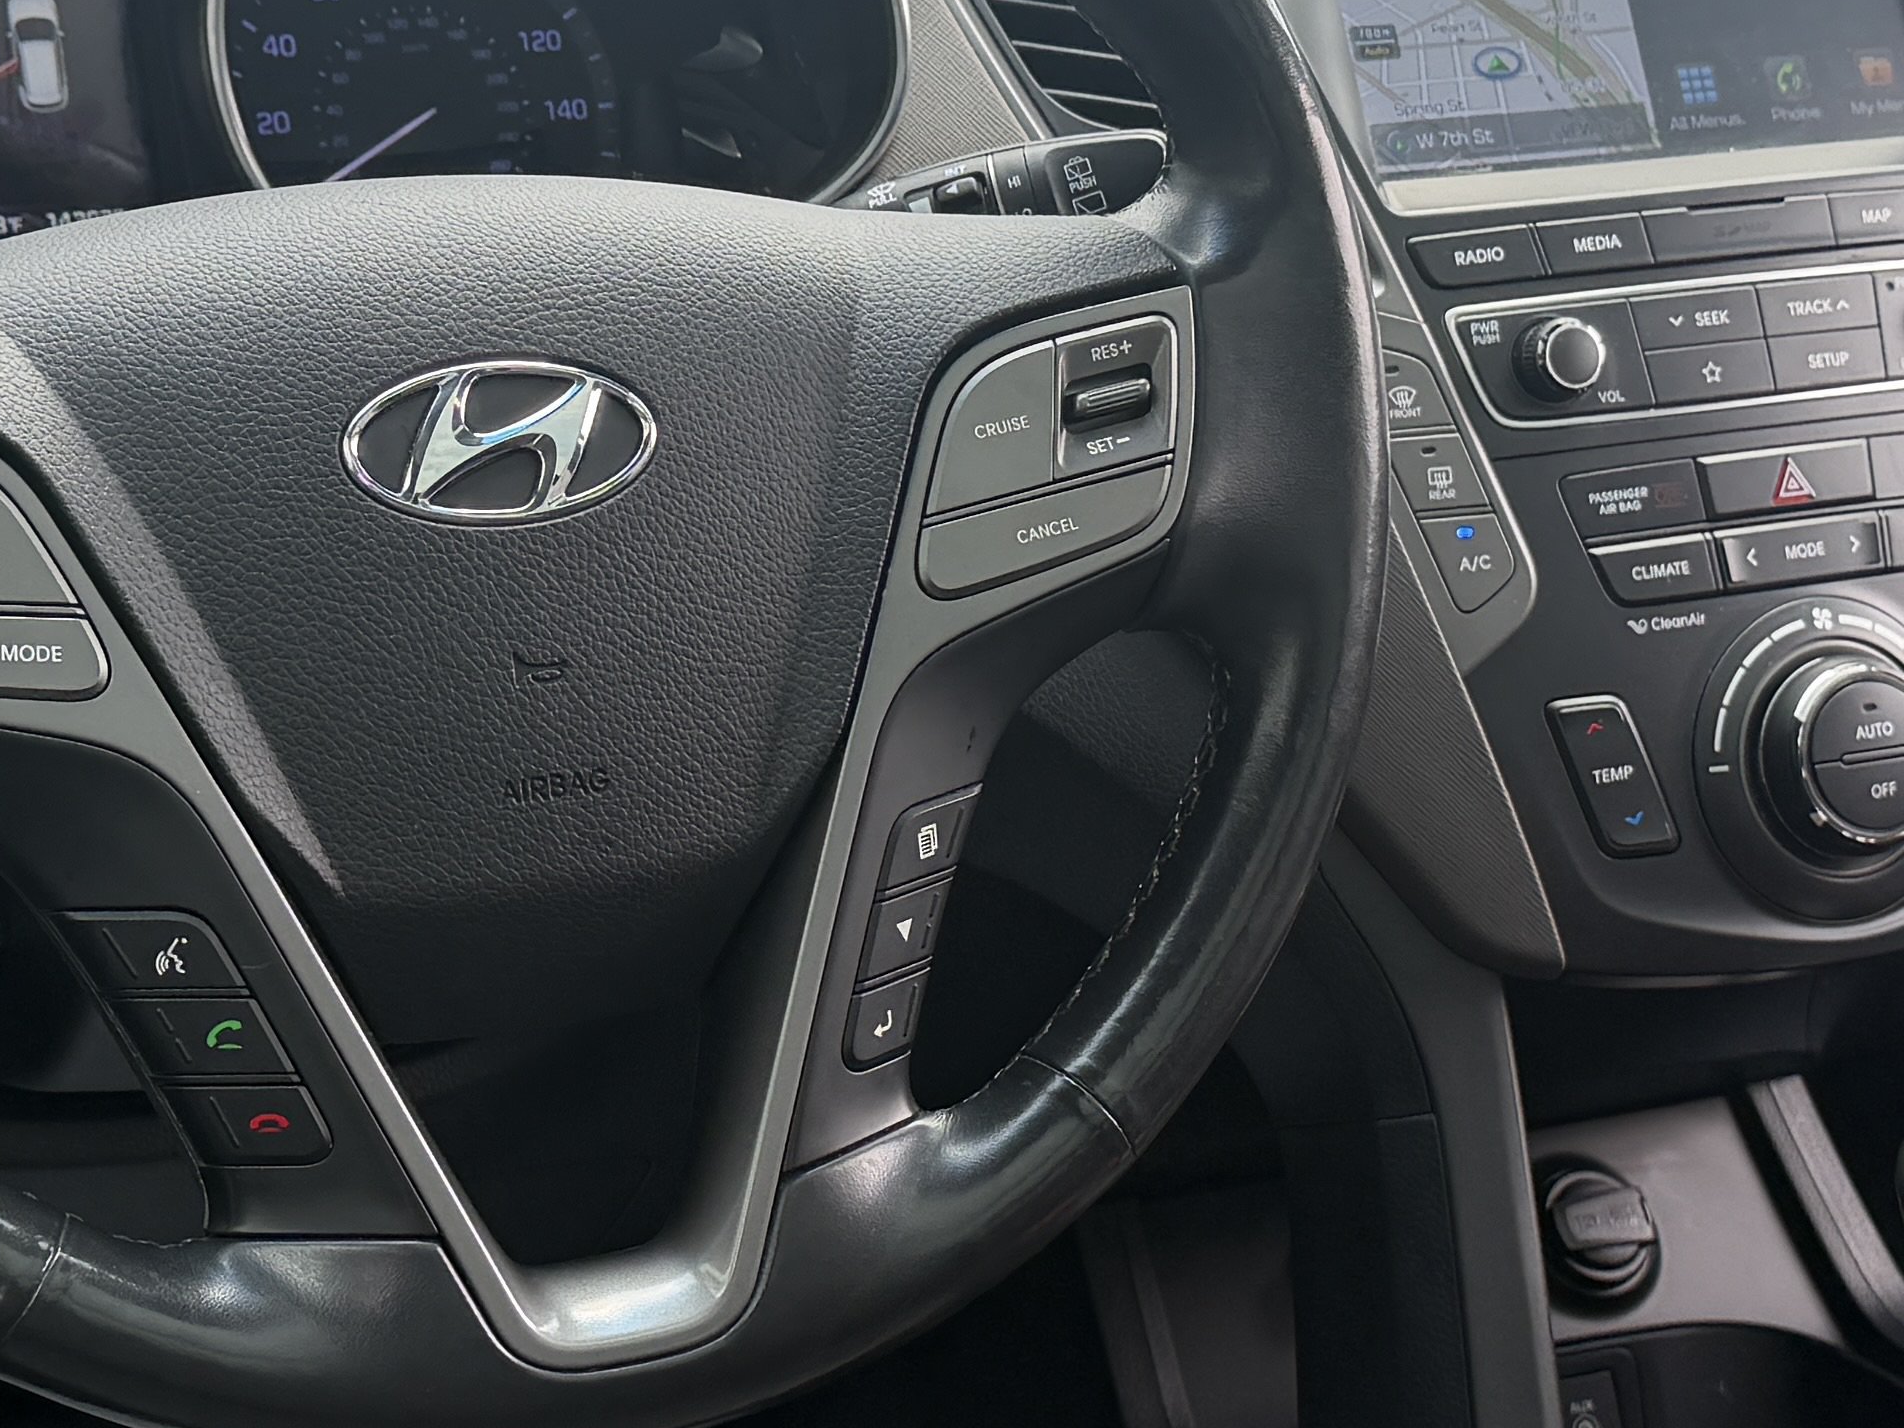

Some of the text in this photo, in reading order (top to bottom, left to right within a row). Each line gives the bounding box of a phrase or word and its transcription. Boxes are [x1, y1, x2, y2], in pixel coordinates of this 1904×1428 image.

[262, 32, 297, 58] 40
[517, 29, 562, 53] 120
[544, 98, 588, 121] 140
[1394, 99, 1465, 118] Spring St
[1770, 105, 1822, 122] Phone
[1850, 101, 1875, 118] My
[256, 110, 292, 136] 20
[1415, 128, 1495, 149] W 7th St
[1008, 175, 1022, 190] HI
[1069, 176, 1098, 194] PUSH
[867, 193, 898, 210] PULL
[1861, 207, 1893, 224] MAP
[1573, 231, 1622, 253] MEDIA
[1453, 245, 1505, 267] RADIO
[1787, 298, 1833, 317] TRACK
[1470, 320, 1499, 335] PWR
[1694, 309, 1731, 328] SEEK
[1472, 334, 1501, 346] PUSH
[1807, 352, 1850, 370] SETUP
[1598, 390, 1626, 404] VOL
[1389, 406, 1423, 419] FRONT
[974, 413, 1031, 440] CRUISE
[1428, 488, 1456, 501] REAR
[1588, 485, 1649, 505] PASSENGER
[1599, 499, 1643, 515] AIR BAG
[1016, 515, 1079, 545] CANCEL
[1784, 539, 1827, 561] MODE
[1459, 554, 1492, 572] A/C
[1631, 558, 1692, 583] CLIMATE
[1650, 610, 1708, 632] CleanAir
[0, 643, 64, 664] MODE
[1855, 719, 1895, 741] AUTO
[1591, 763, 1636, 785] TEMP
[500, 766, 612, 808] AIRBAG
[1869, 779, 1899, 801] OFF
[1569, 1398, 1595, 1414] AUX
